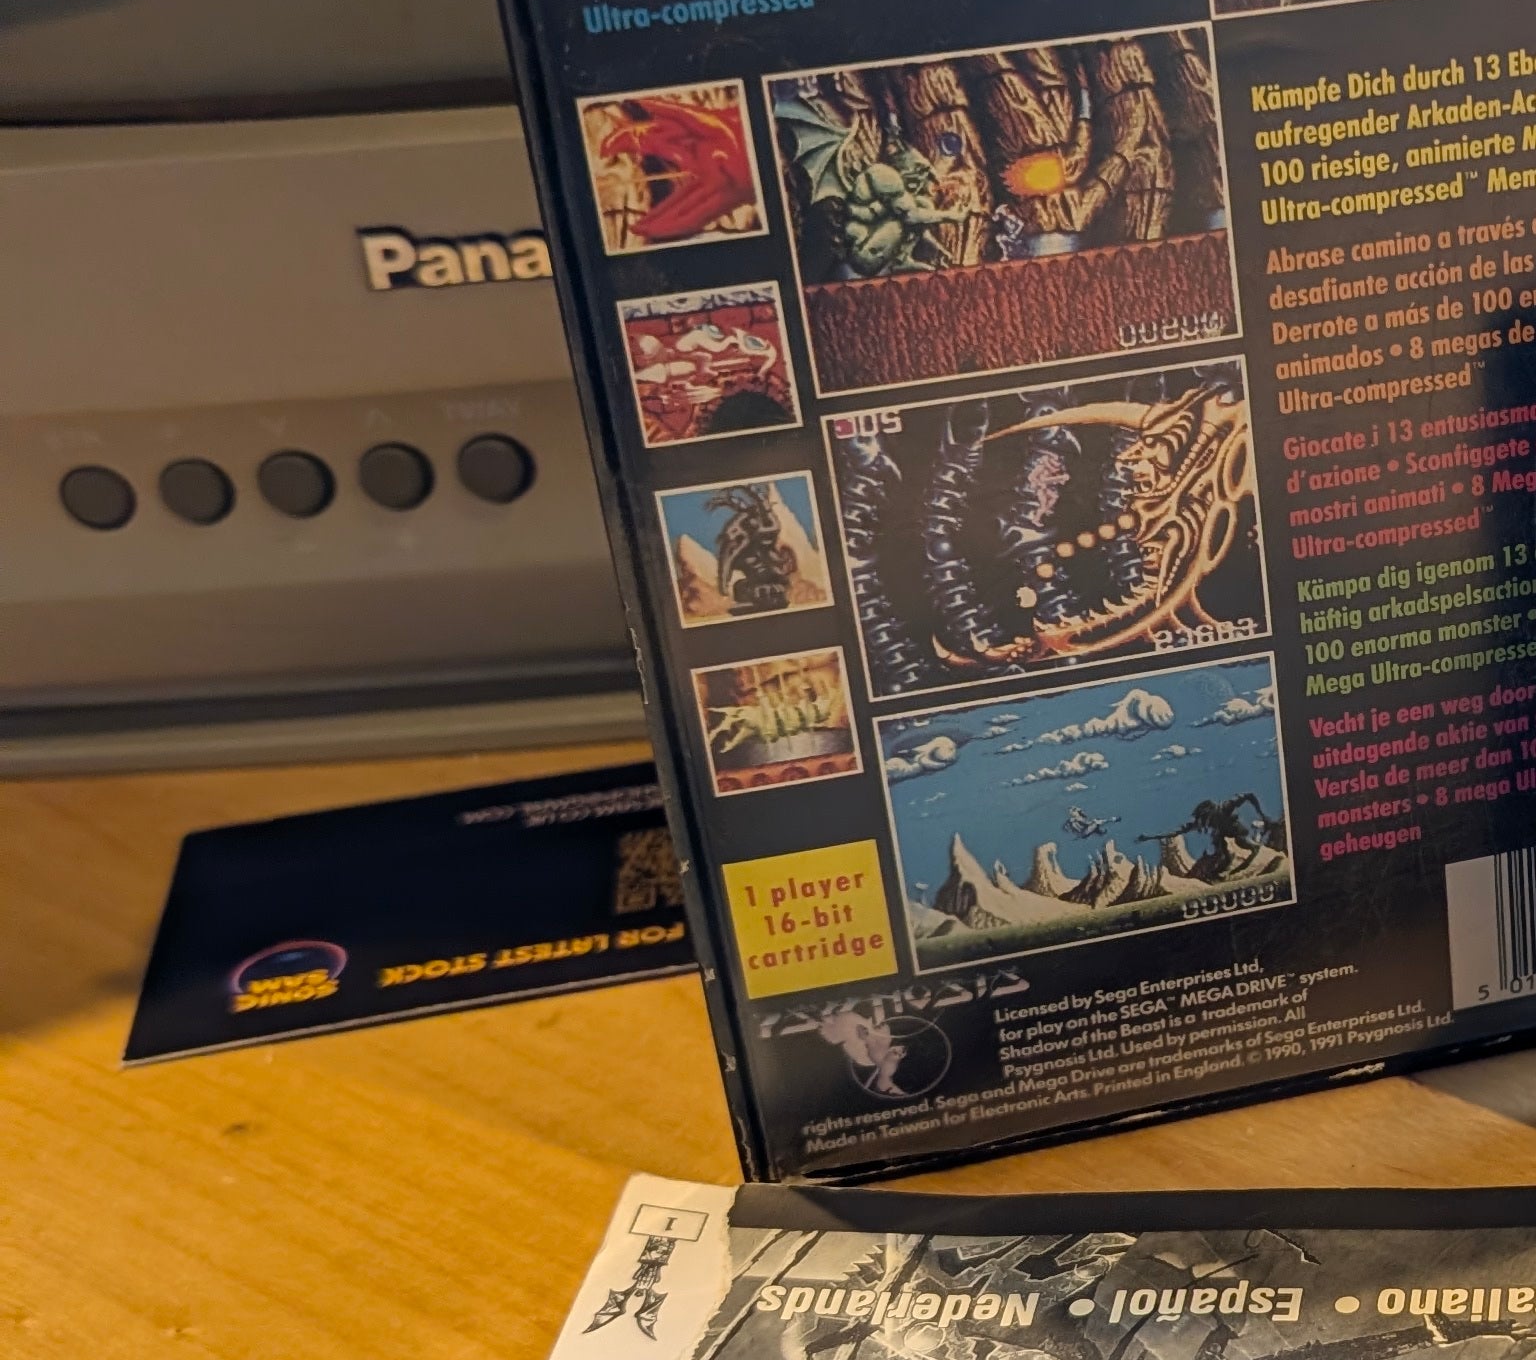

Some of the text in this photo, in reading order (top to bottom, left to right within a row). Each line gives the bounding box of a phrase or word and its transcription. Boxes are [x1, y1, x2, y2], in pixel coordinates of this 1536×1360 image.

[1251, 77, 1340, 111] Kämpfe
[1348, 68, 1395, 98] Dich
[1403, 58, 1464, 91] durch
[1474, 54, 1500, 81] 13
[1255, 108, 1399, 150] aufregender
[1261, 158, 1304, 186] 100
[1311, 150, 1398, 180] riesige,
[1406, 133, 1515, 167] animierte
[1266, 247, 1344, 274] Abrase
[1351, 232, 1430, 261] camino
[1437, 231, 1451, 248] a
[1457, 216, 1525, 245] través
[1269, 275, 1388, 309] desafiante
[1395, 262, 1462, 291] acción
[1469, 255, 1496, 280] de
[1503, 250, 1534, 274] las
[1272, 316, 1357, 344] Derrote
[1365, 314, 1378, 331] a
[1385, 302, 1429, 328] más
[1436, 295, 1463, 320] de
[1472, 287, 1512, 314] 100
[1287, 464, 1380, 493] d'azione
[1406, 439, 1529, 474] Sconfiggete
[1300, 606, 1362, 634] häftig
[1306, 672, 1364, 696] Mega
[1309, 712, 1364, 737] Vecht
[1370, 708, 1390, 732] je
[1396, 703, 1434, 723] een
[1440, 695, 1483, 714] weg
[1489, 685, 1536, 706] door
[1320, 826, 1421, 860] geheugen
[744, 871, 865, 908] 1 player
[764, 903, 854, 937] 16-bit
[374, 921, 685, 988] FOR LATEST STOCK
[747, 933, 886, 970] cartridge
[995, 996, 1068, 1022] Licensed
[1072, 995, 1092, 1009] by
[1094, 987, 1137, 1004] Sega
[1140, 969, 1231, 995] Enterprises
[999, 1028, 1023, 1041] for
[1026, 1021, 1063, 1040] play
[1066, 1017, 1088, 1029] on
[1090, 1010, 1117, 1024] the
[1180, 985, 1234, 1007] MEGA
[1299, 965, 1358, 985] system.
[1478, 984, 1490, 1001] 5
[1000, 988, 1307, 1060] Shadow of the Beast is a trademark of
[1004, 1006, 1305, 1077] Psygnosis Ltd. Used by permission. All
[757, 1283, 1040, 1326] Nederlands
[1110, 1280, 1304, 1323] Español
